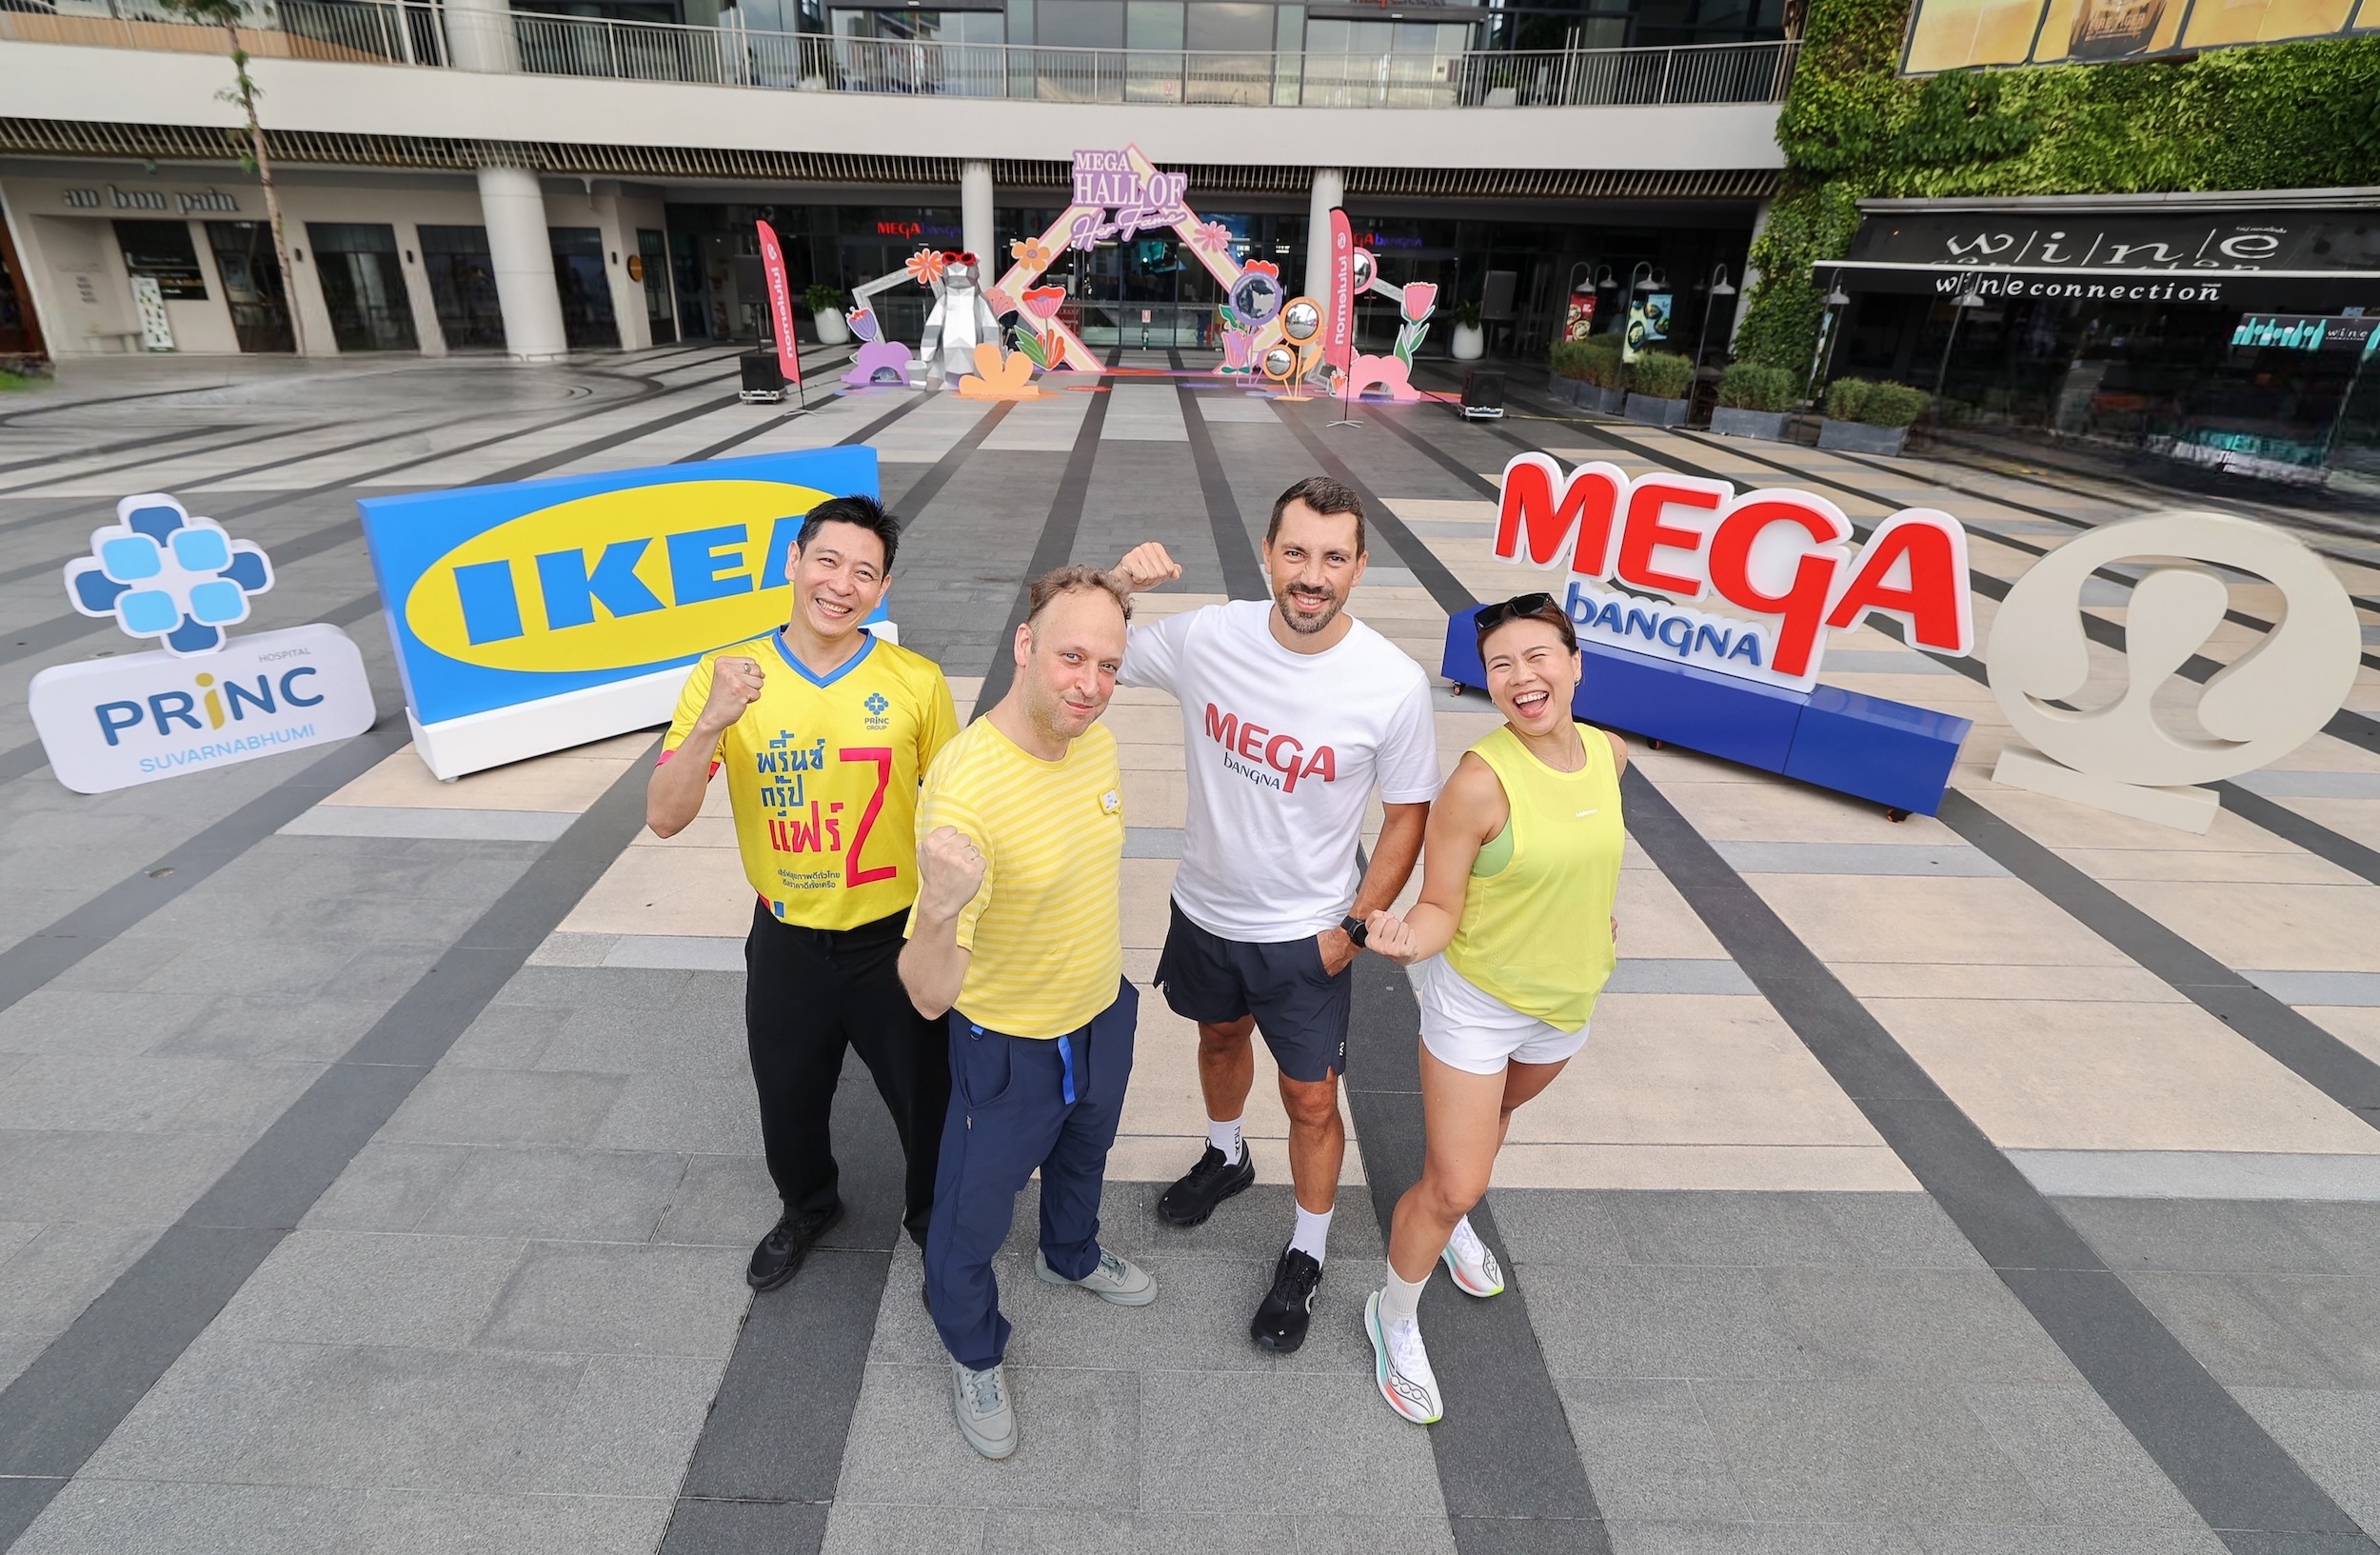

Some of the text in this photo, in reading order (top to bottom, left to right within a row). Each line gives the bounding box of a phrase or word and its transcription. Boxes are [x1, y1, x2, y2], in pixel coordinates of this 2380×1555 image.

[1075, 152, 1130, 172] MEGA
[63, 189, 100, 208] au
[107, 184, 167, 210] bon
[1075, 172, 1185, 207] HALL OF
[877, 221, 921, 239] MEGA
[1073, 206, 1185, 249] Her Fame
[2030, 282, 2219, 302] connection
[1495, 463, 1961, 677] MEGA
[258, 648, 312, 664] HOSPITAL
[139, 724, 316, 773] SUVARNABHUMI
[1205, 702, 1336, 794] MEGA
[768, 800, 844, 853] แฟร์
